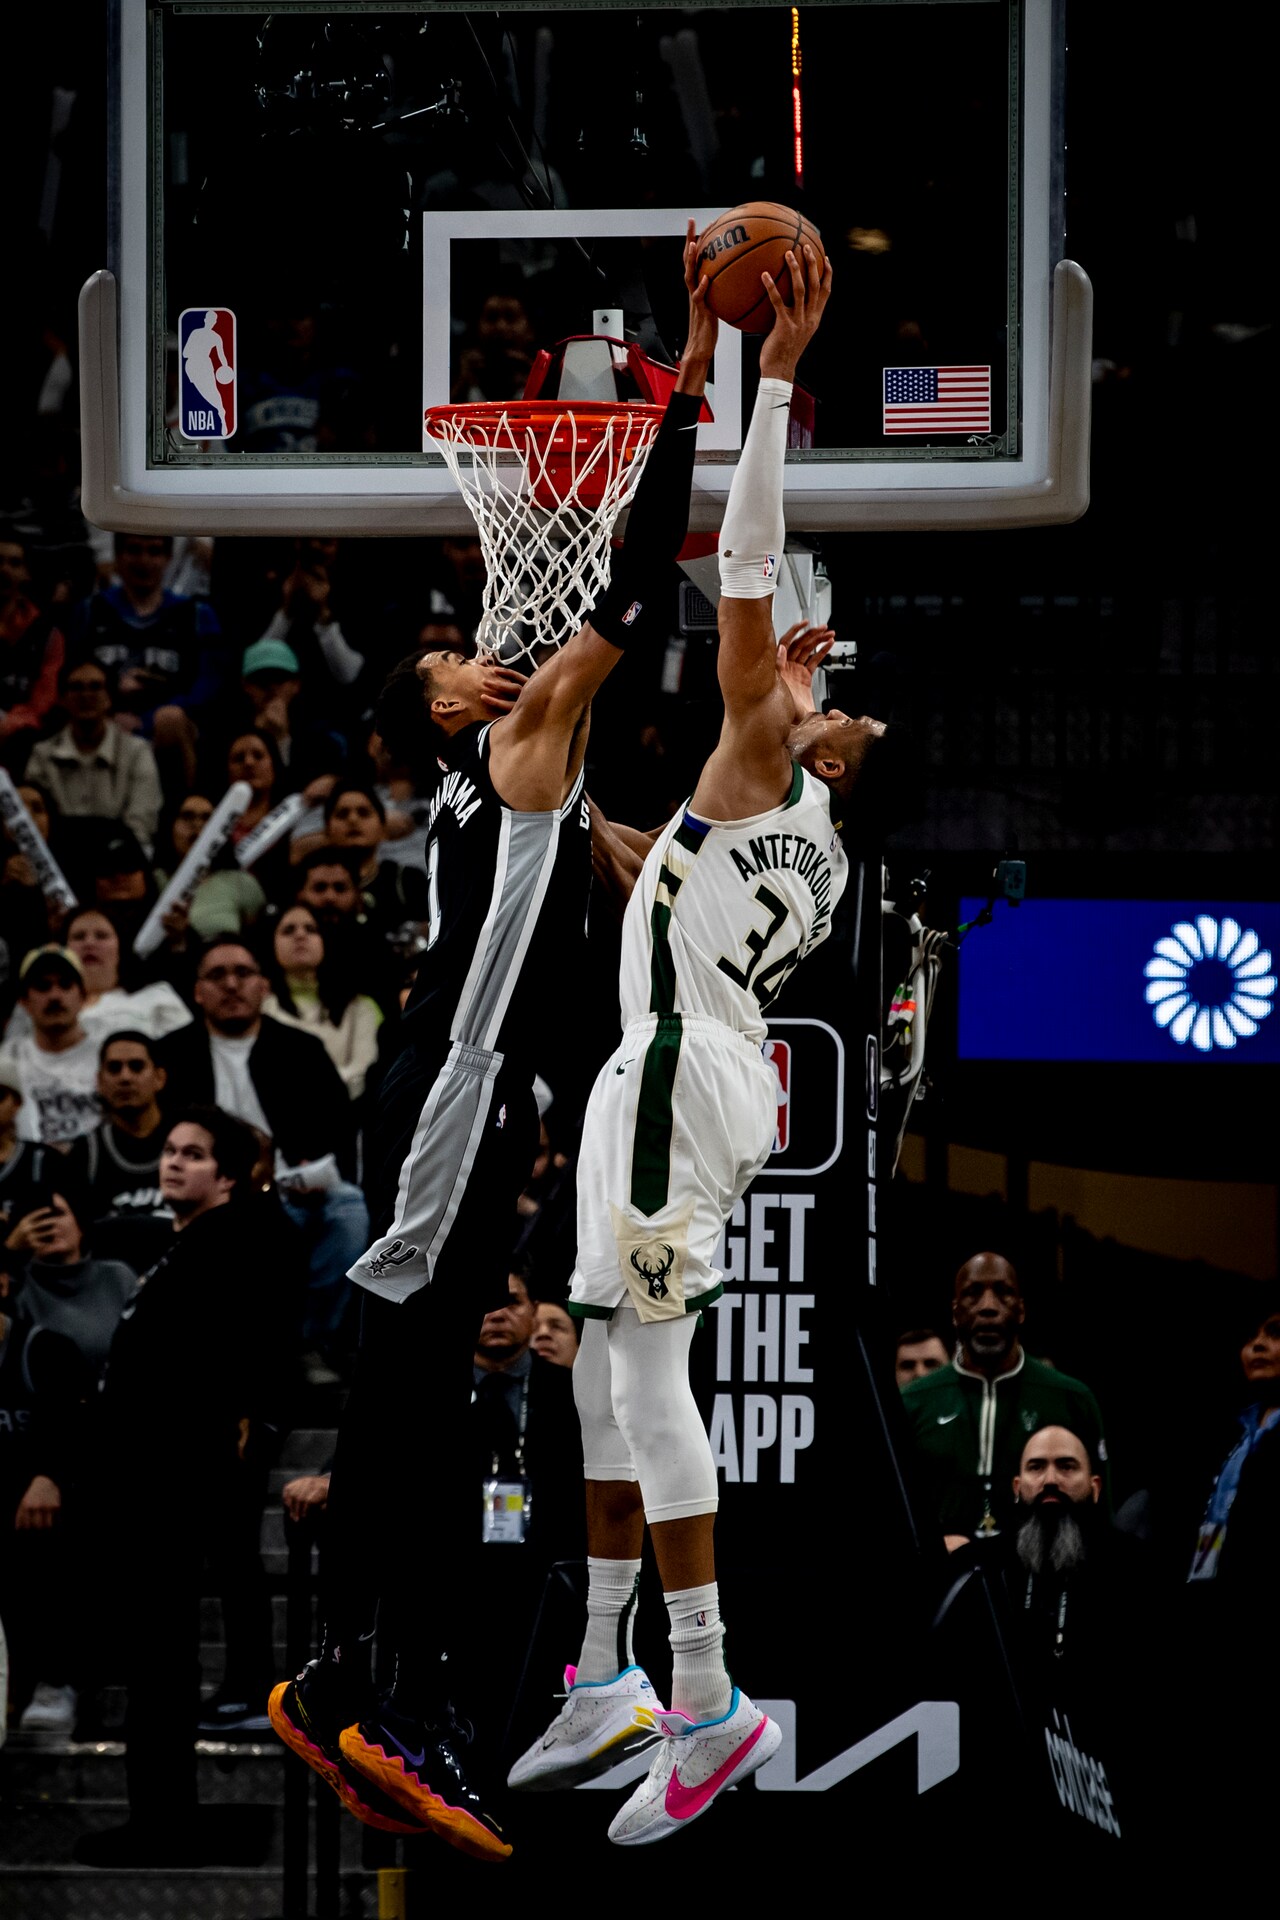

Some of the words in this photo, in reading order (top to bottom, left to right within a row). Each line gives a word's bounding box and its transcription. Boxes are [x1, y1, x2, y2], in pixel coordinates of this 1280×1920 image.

[188, 410, 215, 431] NBA
[427, 836, 441, 951] 1
[711, 1193, 816, 1283] GET
[709, 1293, 816, 1383] THE
[708, 1393, 816, 1484] APP
